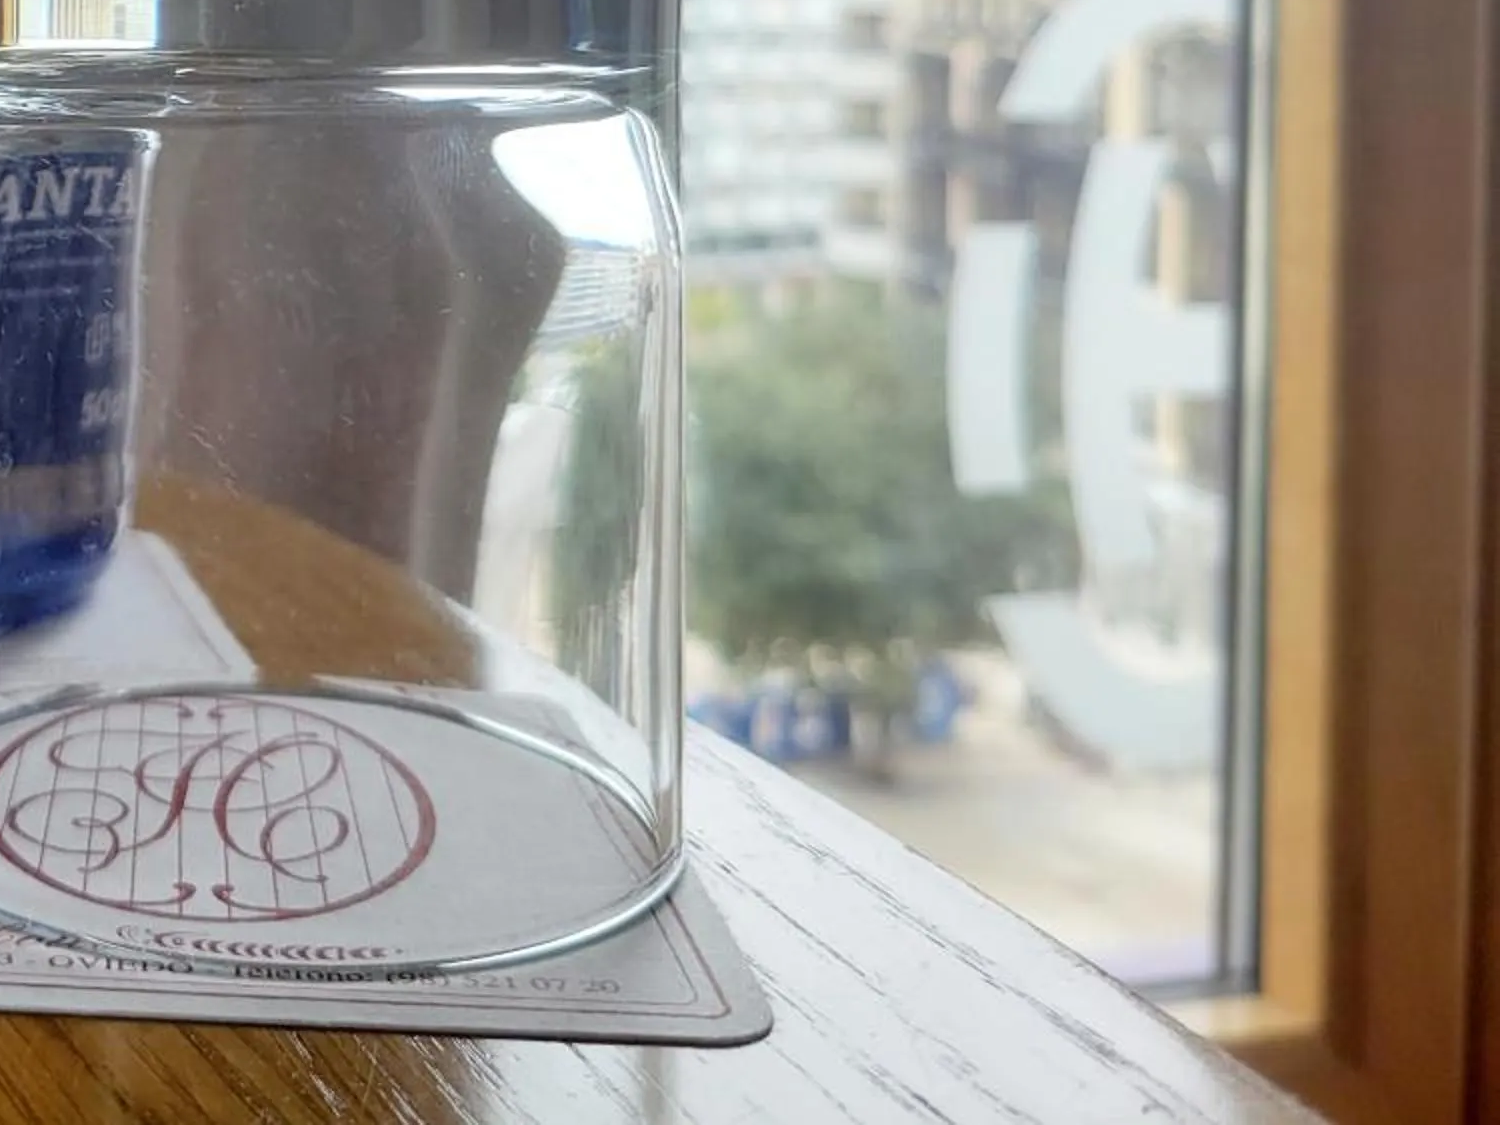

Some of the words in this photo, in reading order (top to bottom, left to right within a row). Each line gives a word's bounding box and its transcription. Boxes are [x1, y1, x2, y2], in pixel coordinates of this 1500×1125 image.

[47, 954, 194, 974] OVIEDO
[463, 974, 517, 989] 521
[529, 976, 568, 992] 07
[577, 978, 621, 995] 20
